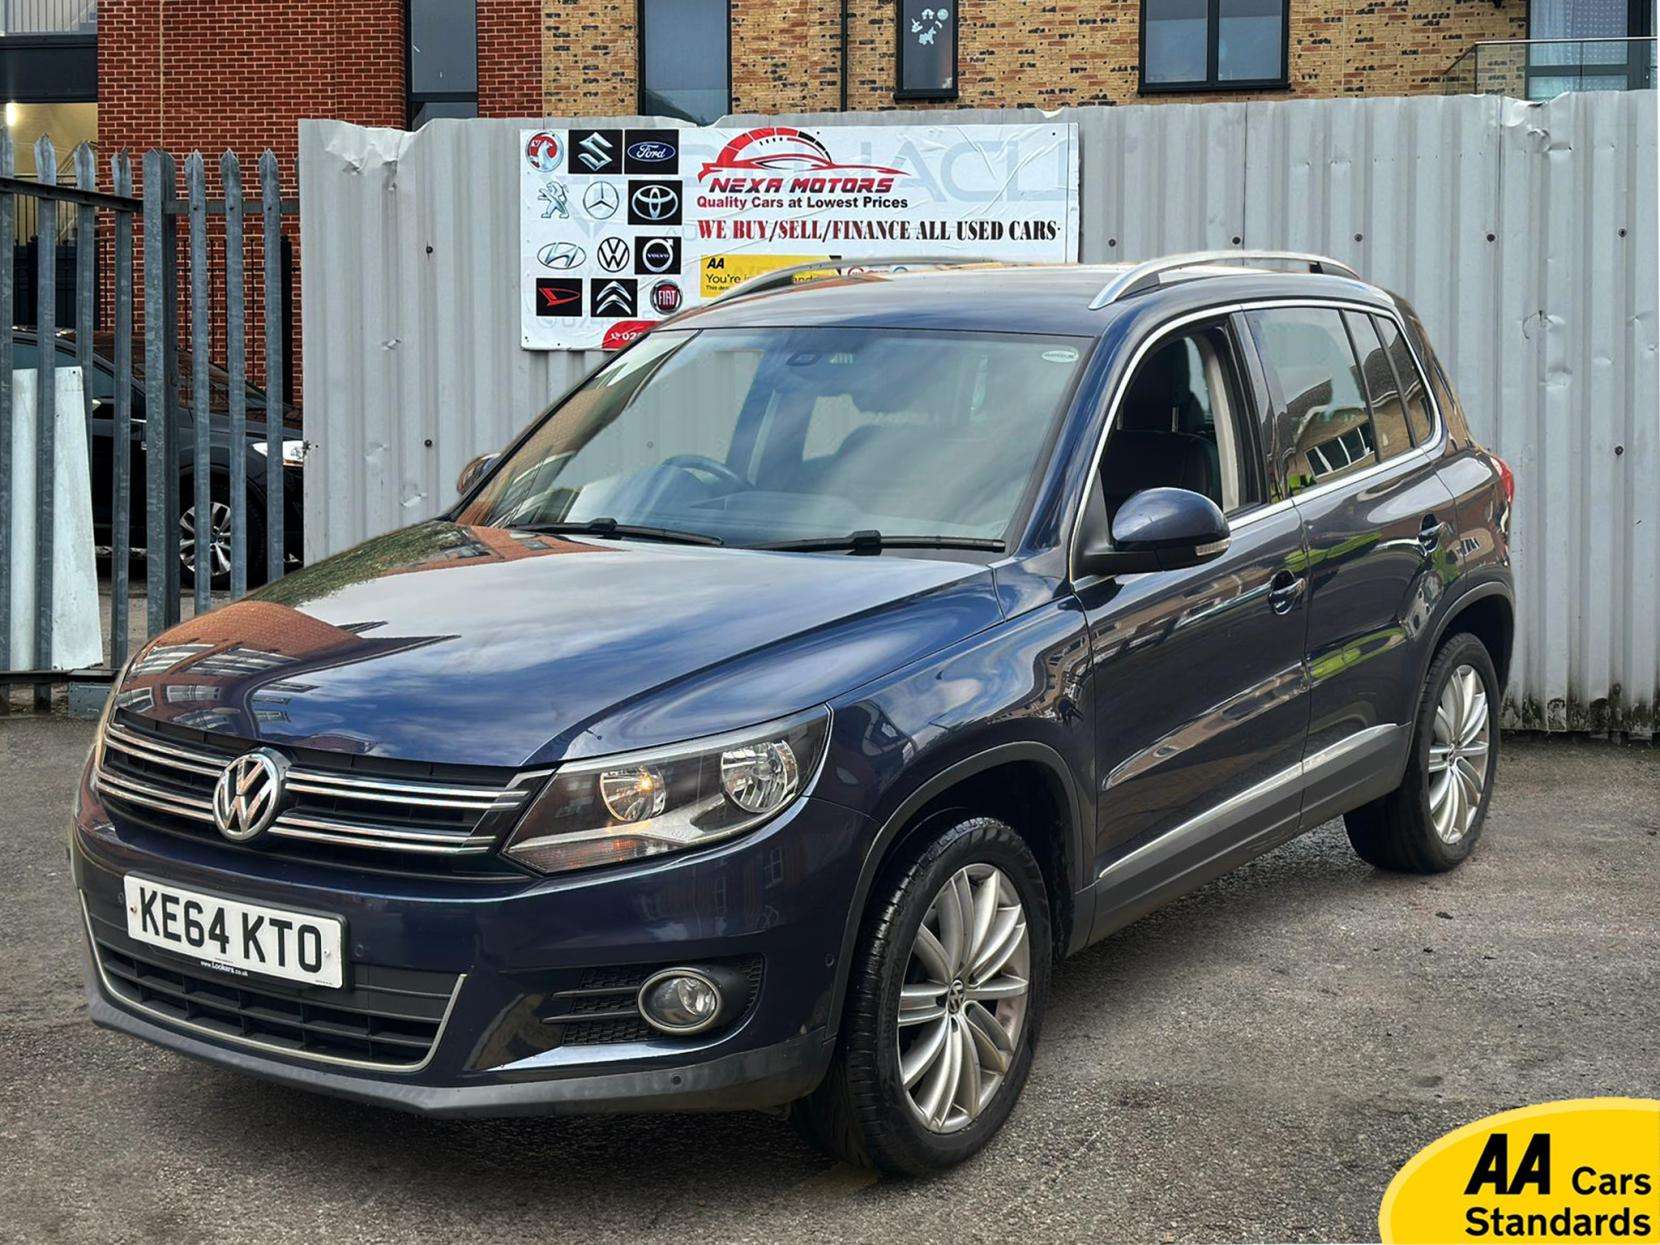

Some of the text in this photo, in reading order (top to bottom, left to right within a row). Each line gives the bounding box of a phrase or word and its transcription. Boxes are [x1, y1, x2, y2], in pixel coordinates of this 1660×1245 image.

[636, 144, 666, 159] Ford
[709, 178, 895, 193] NEXA MOTORS
[697, 196, 908, 211] Quality Cars at Lowest Prices
[697, 220, 726, 239] WE
[733, 220, 911, 242] BUY/SELL/FINANCE
[916, 220, 950, 240] ALL
[956, 220, 1004, 241] USED
[1008, 220, 1057, 241] CARS
[706, 258, 725, 269] AA
[706, 273, 740, 284] You're
[658, 290, 676, 306] FIAT
[139, 886, 323, 974] KE64 KTO
